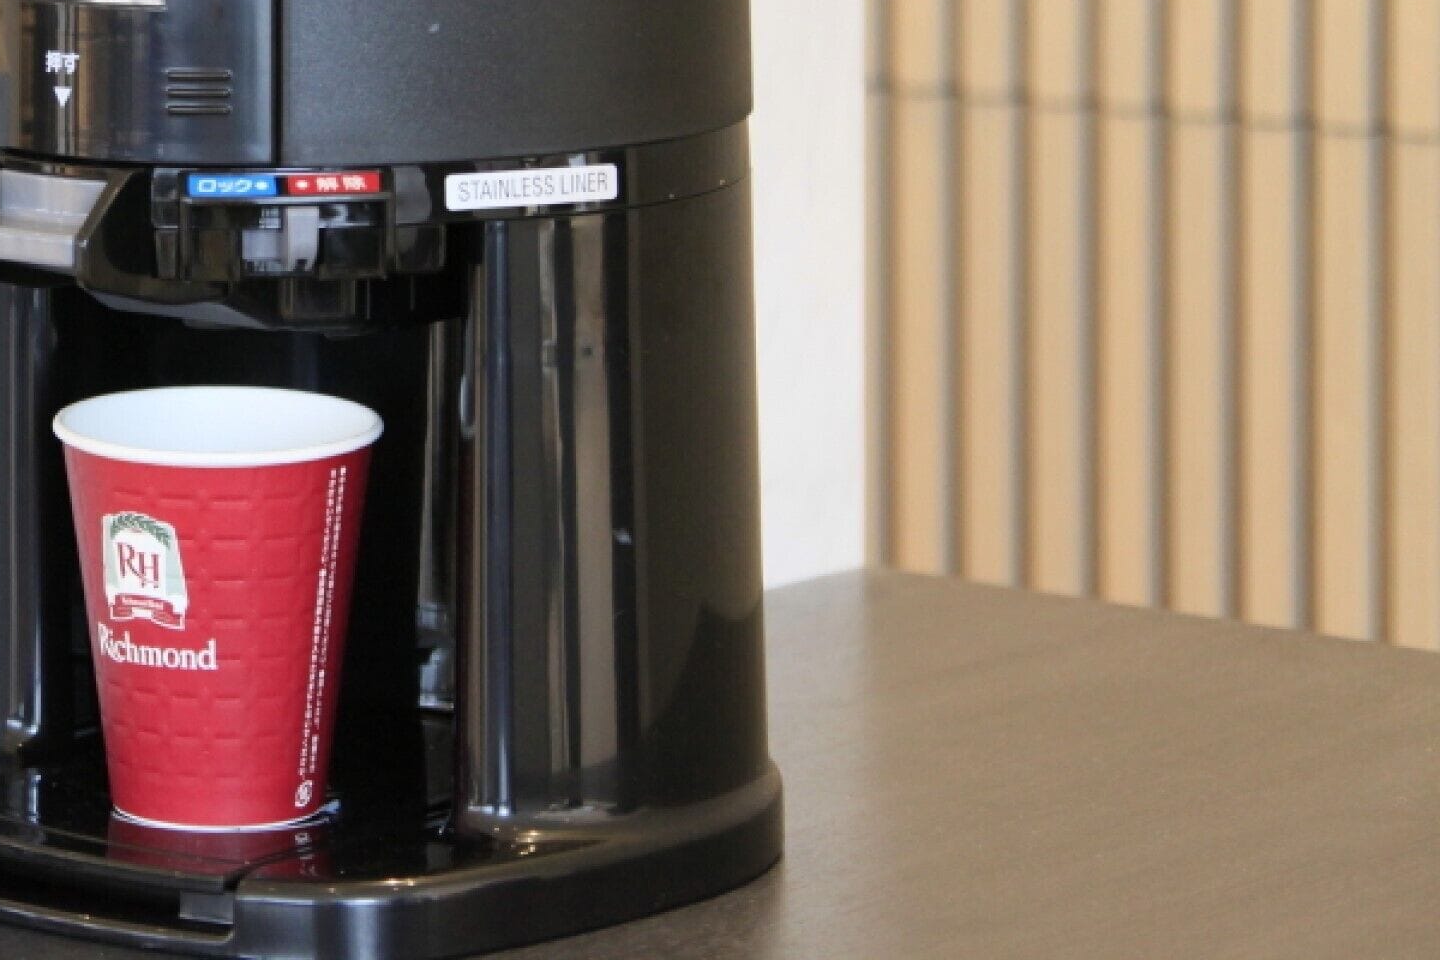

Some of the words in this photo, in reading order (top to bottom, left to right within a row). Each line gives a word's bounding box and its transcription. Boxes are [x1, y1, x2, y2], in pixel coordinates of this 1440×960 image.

[458, 174, 555, 202] STAINLESS
[561, 172, 609, 195] LINER
[117, 542, 160, 588] RH
[97, 622, 218, 670] Richmond
